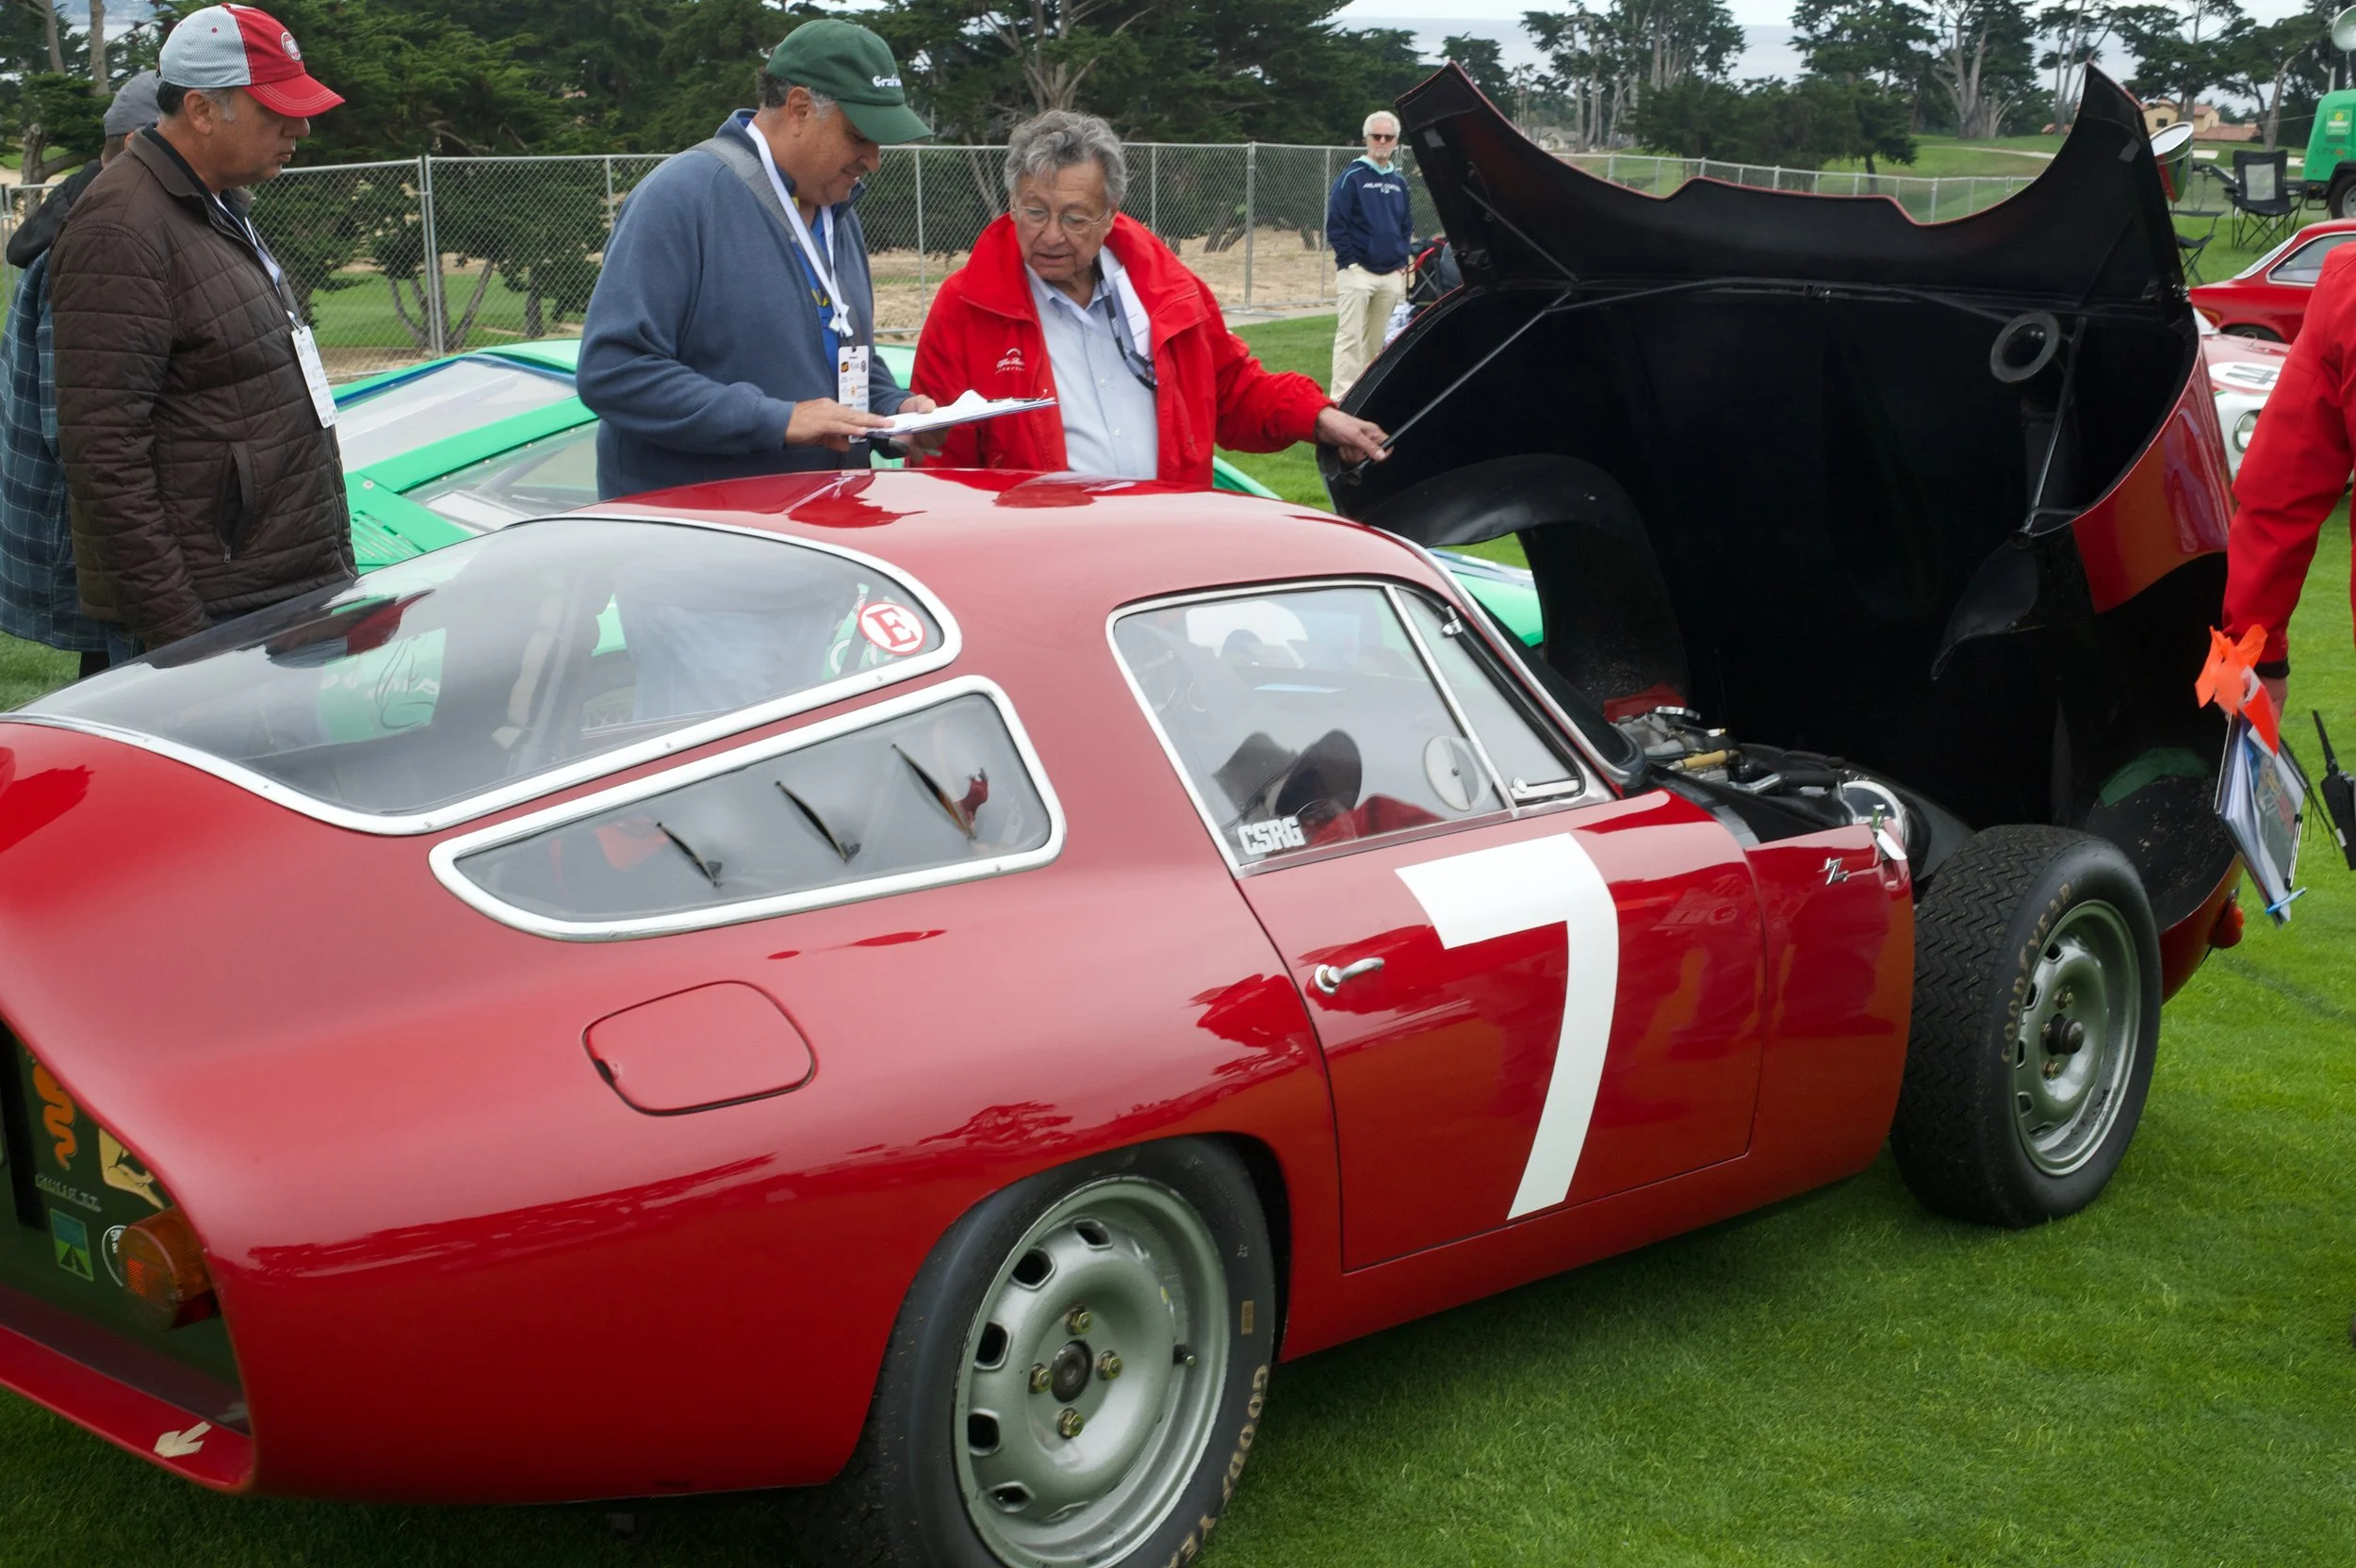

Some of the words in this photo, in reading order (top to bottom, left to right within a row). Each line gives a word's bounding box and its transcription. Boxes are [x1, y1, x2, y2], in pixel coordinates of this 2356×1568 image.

[866, 607, 918, 647] E
[1237, 815, 1306, 856] CSRG
[1394, 832, 1620, 1221] 7
